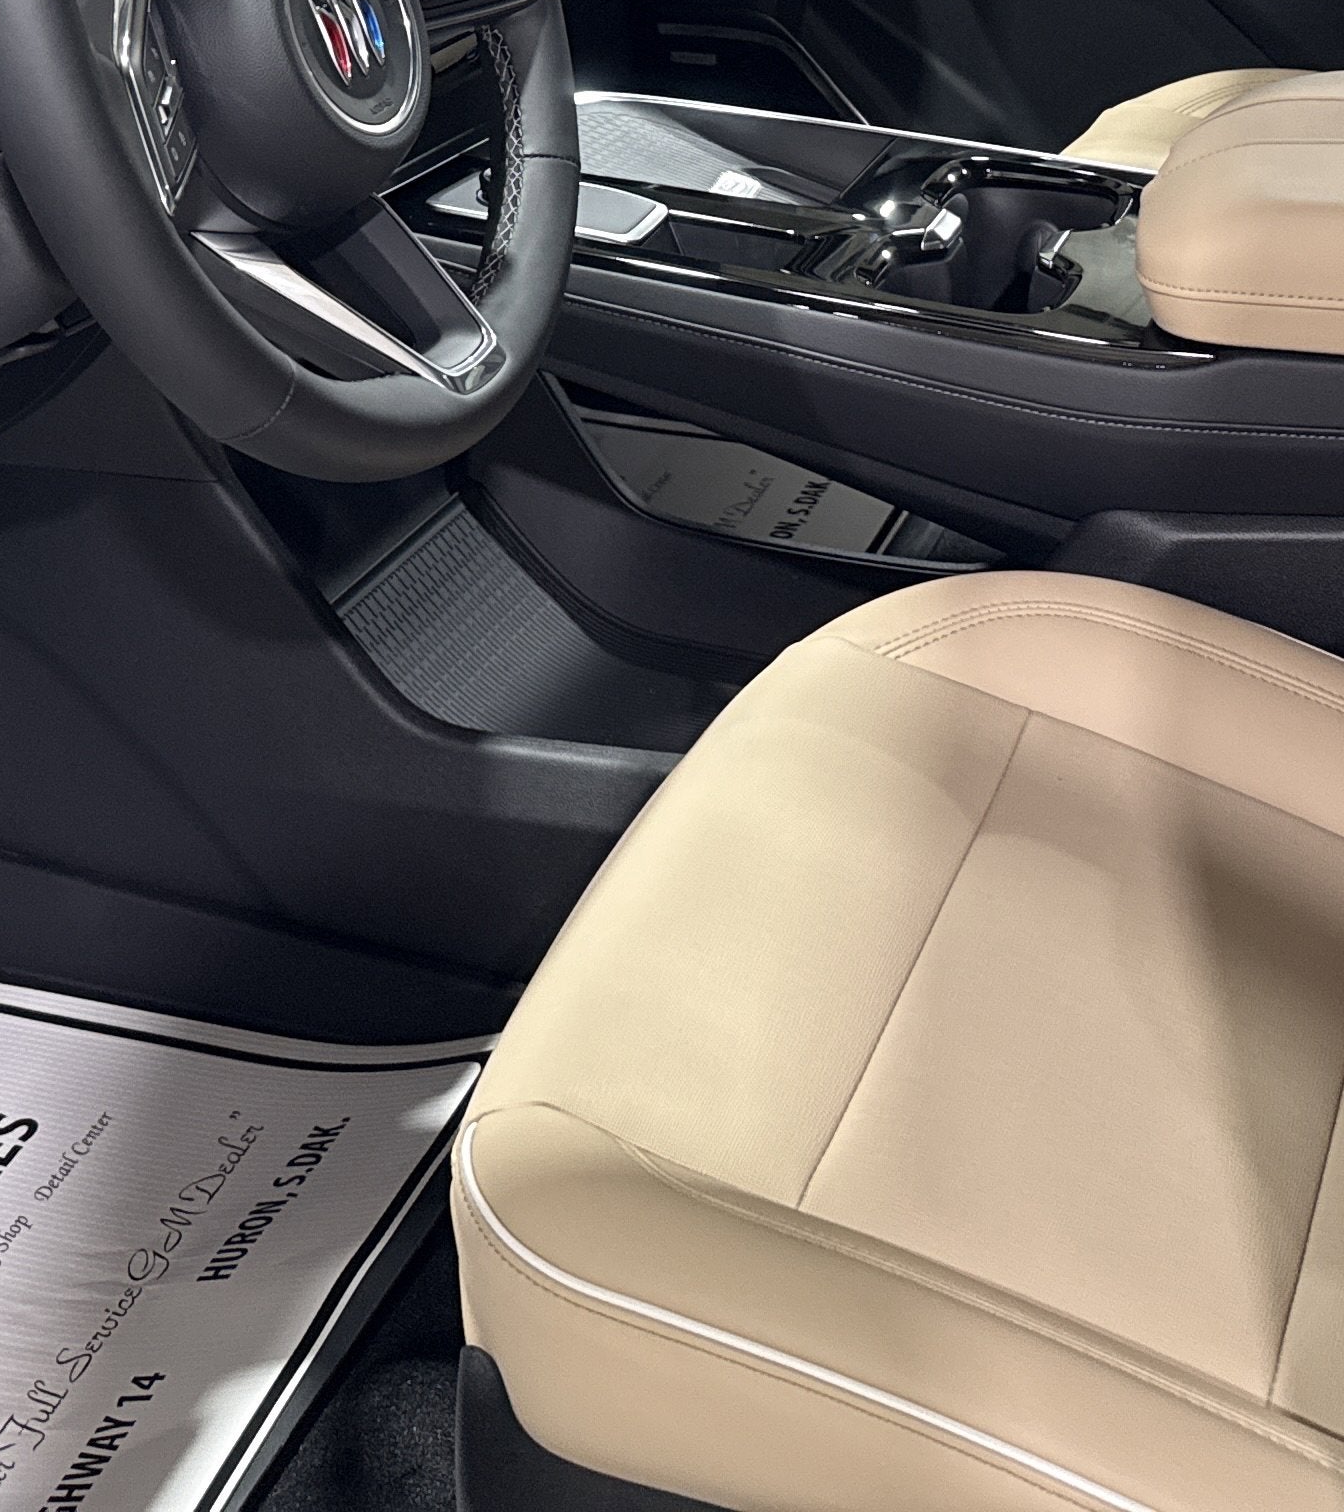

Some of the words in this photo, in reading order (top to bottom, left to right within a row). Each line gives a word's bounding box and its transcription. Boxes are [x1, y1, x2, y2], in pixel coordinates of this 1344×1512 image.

[33, 1151, 79, 1203] Detail
[71, 1110, 115, 1157] Center
[56, 1285, 144, 1384] Service
[116, 1371, 168, 1411] 14
